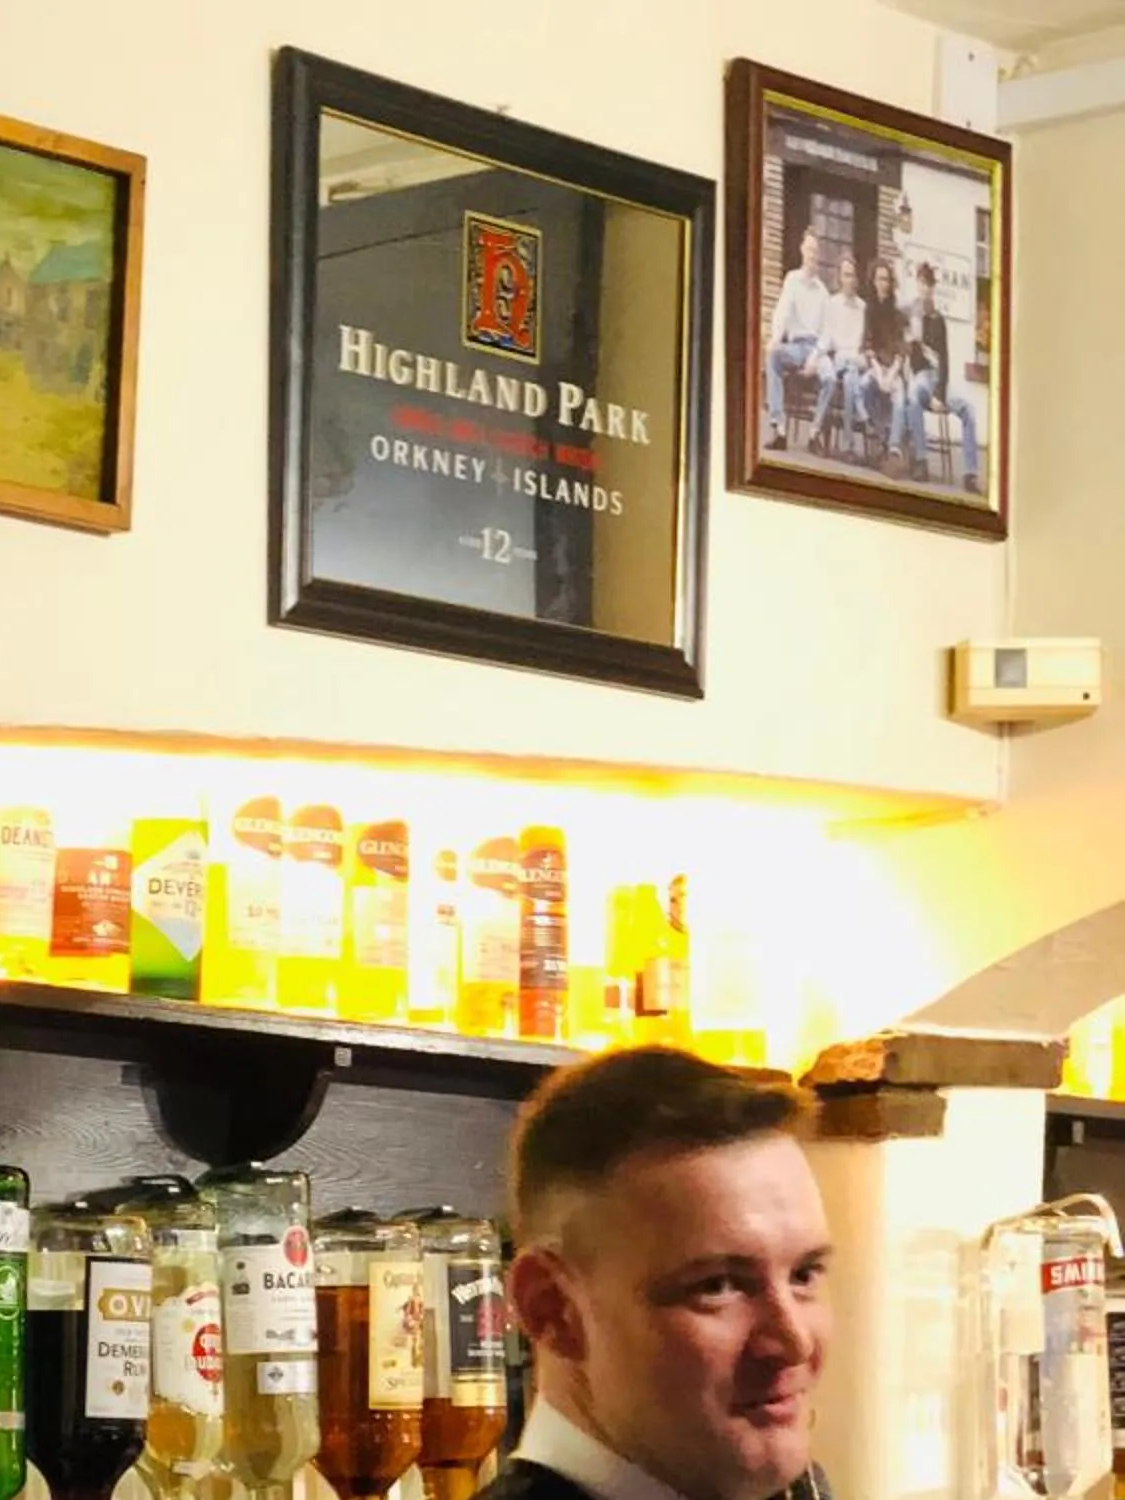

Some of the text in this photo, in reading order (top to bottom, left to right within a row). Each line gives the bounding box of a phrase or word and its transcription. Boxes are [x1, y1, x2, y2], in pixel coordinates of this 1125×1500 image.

[338, 325, 651, 445] HIGHLAND PARK
[370, 435, 487, 484] ORKNEY
[513, 467, 624, 516] ISLANDS
